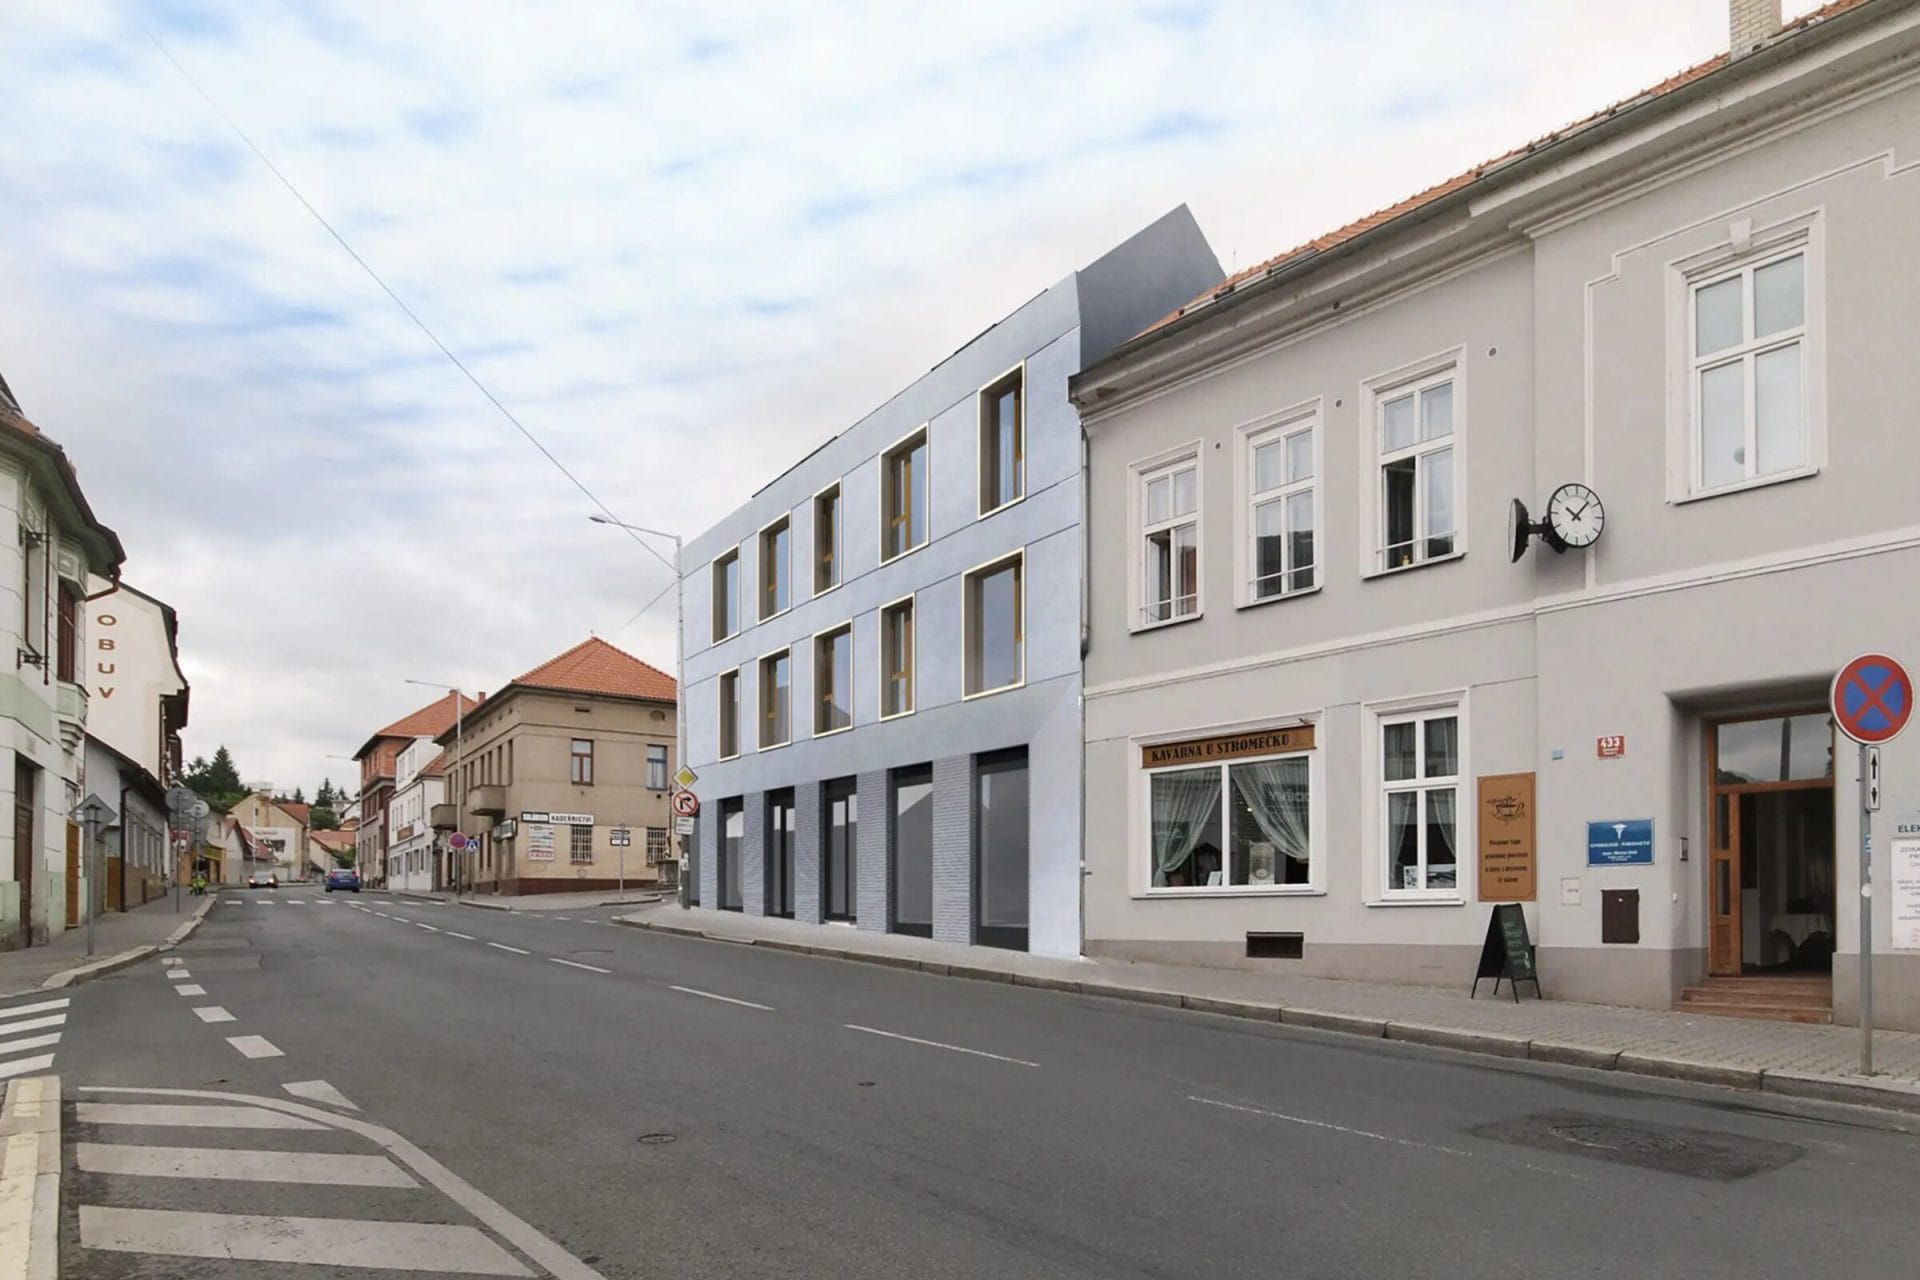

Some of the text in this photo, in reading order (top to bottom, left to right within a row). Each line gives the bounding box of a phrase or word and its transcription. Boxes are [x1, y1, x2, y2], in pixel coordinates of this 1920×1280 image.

[97, 614, 117, 699] OBUV
[1152, 733, 1290, 762] KAVÁRNA U STROMEČKU
[1600, 736, 1620, 748] 433
